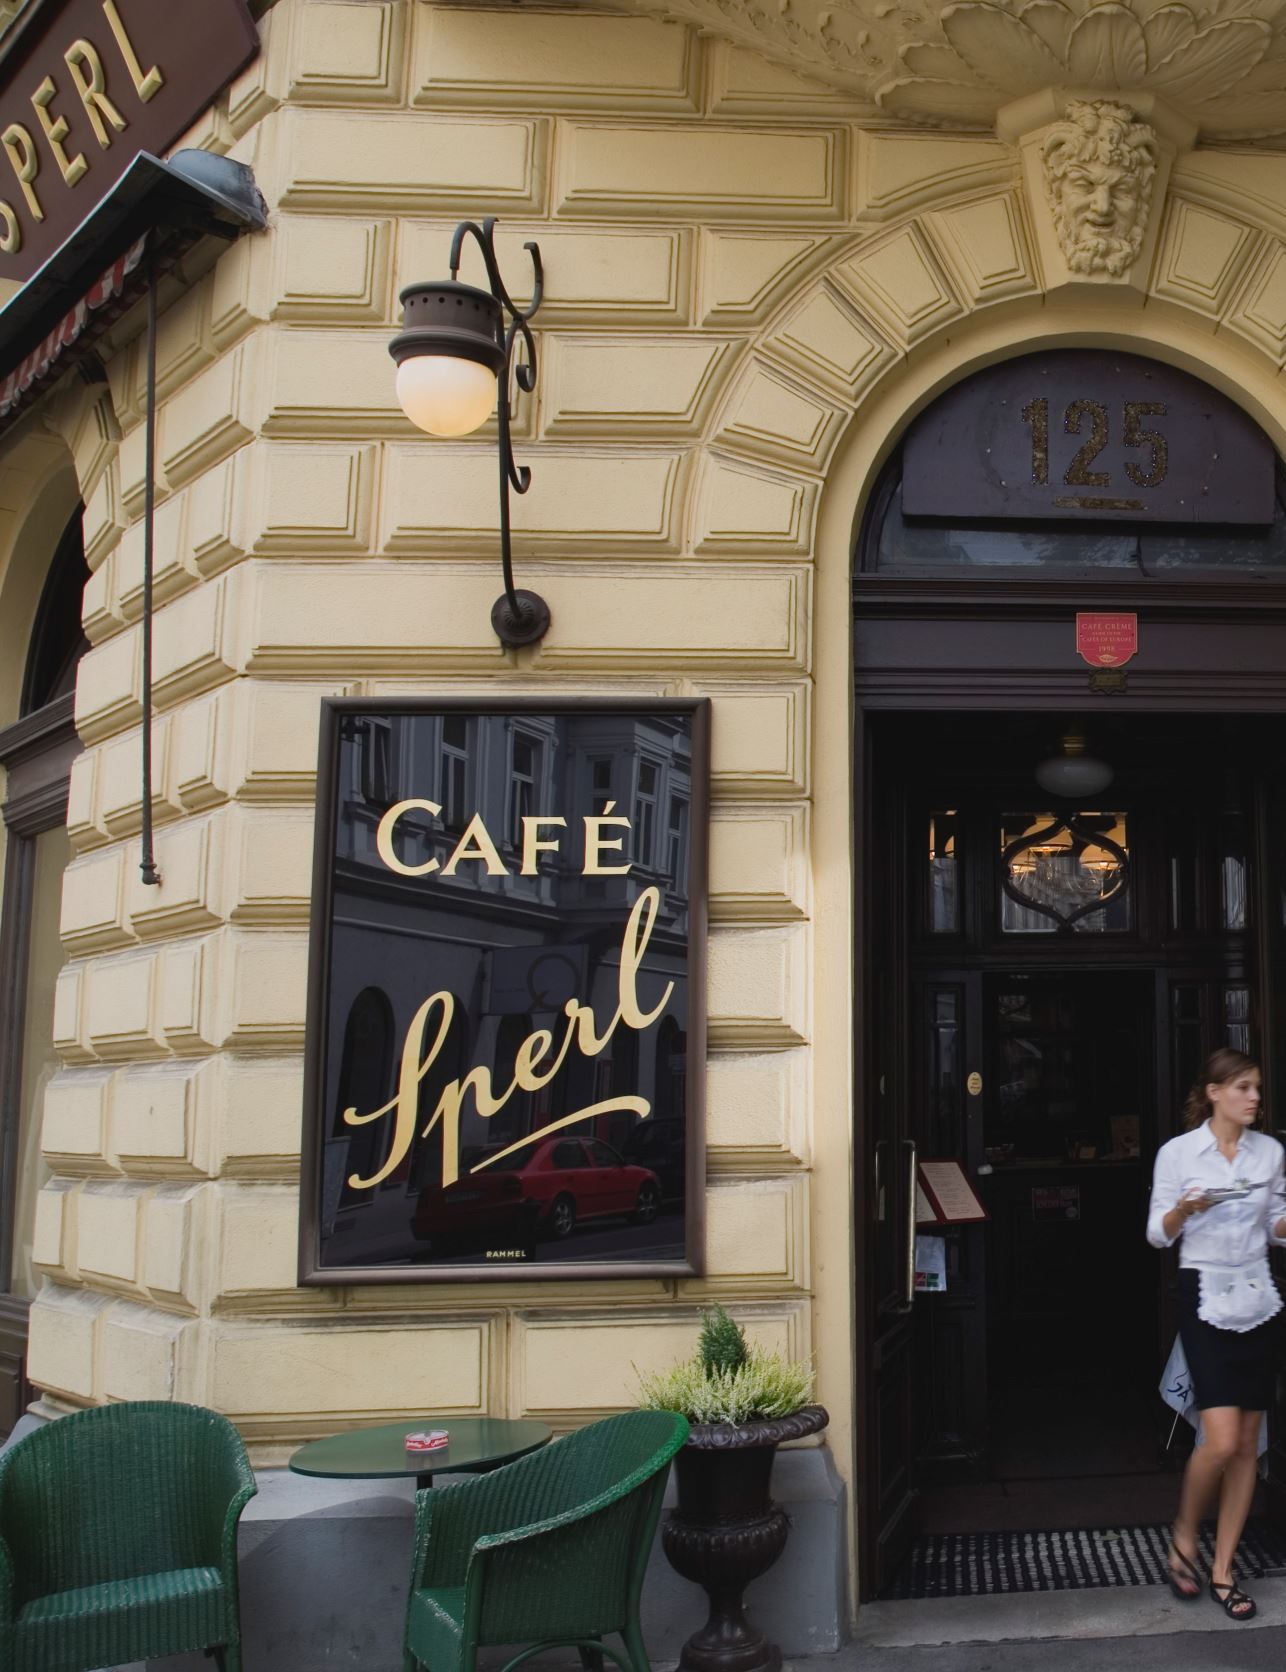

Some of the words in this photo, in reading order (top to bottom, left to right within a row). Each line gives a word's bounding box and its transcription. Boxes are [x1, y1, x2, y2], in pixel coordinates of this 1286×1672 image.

[1022, 397, 1169, 488] 125
[376, 798, 633, 876] CAFÉ
[343, 885, 675, 1189] Sperl
